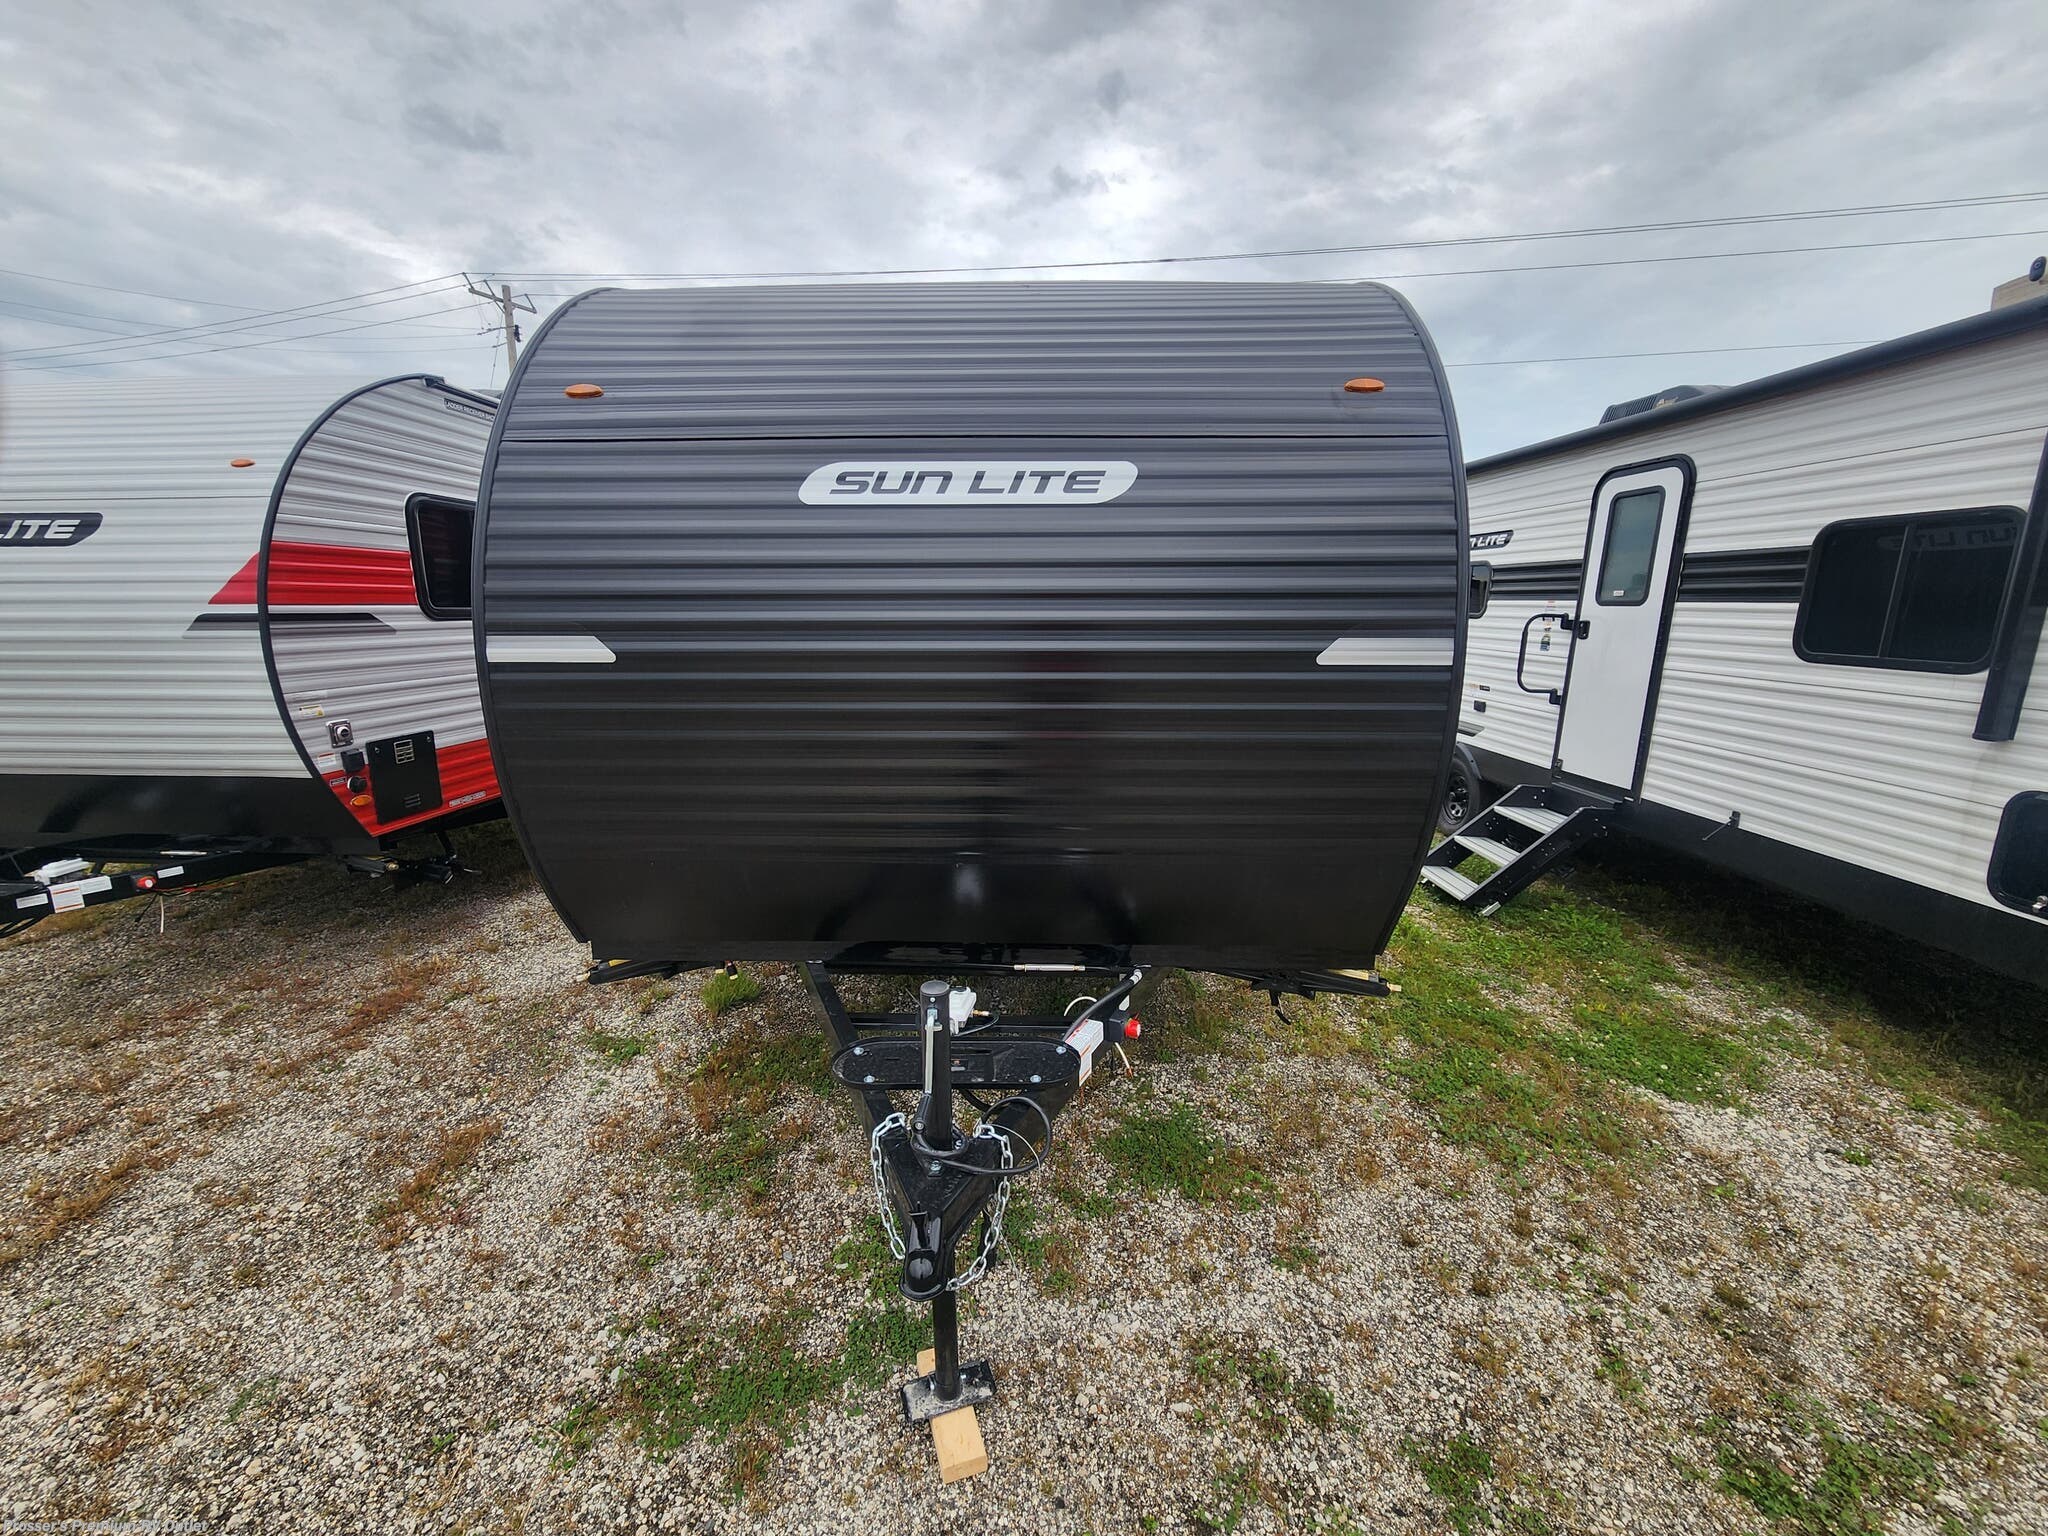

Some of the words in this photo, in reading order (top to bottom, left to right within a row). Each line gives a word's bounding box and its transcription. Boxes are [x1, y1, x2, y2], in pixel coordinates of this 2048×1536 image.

[829, 470, 953, 494] SUN
[967, 470, 1107, 494] LITE
[0, 519, 82, 539] ITE
[1477, 534, 1508, 547] LITE
